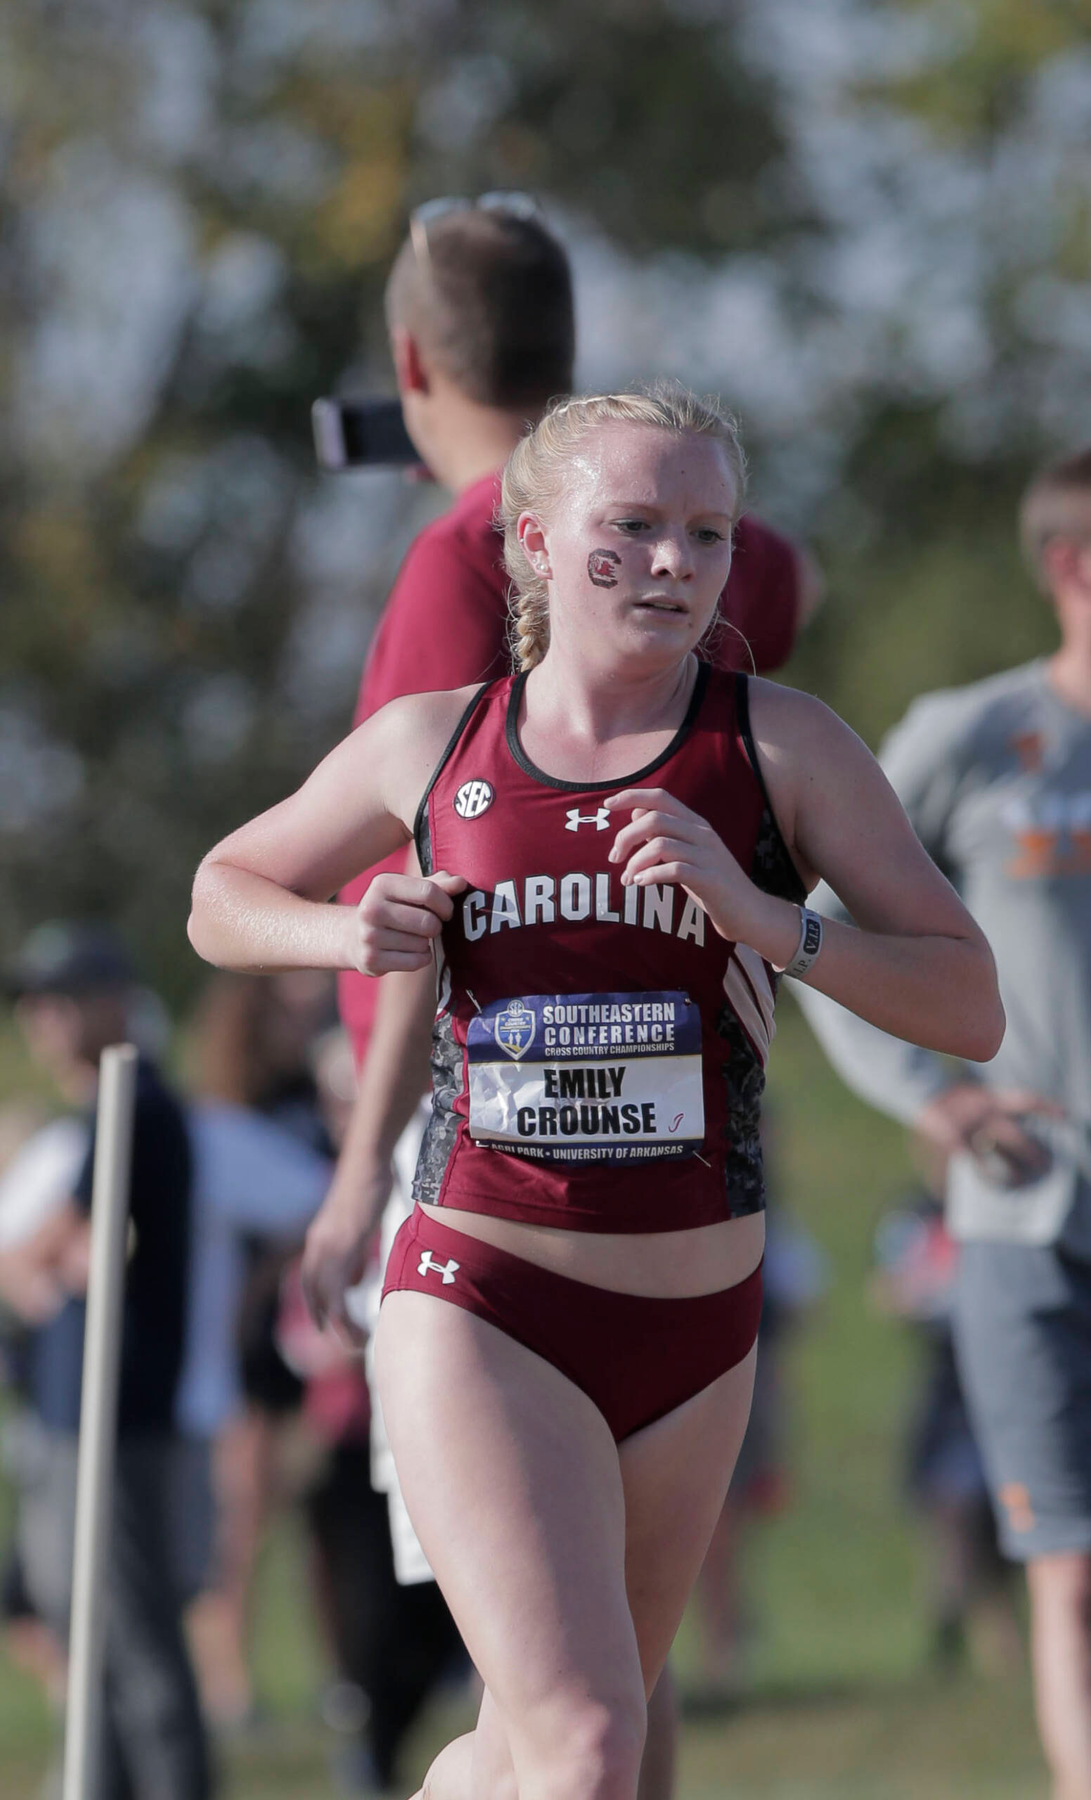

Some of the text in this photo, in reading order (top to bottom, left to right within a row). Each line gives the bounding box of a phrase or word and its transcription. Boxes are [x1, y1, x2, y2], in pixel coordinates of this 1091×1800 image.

[455, 781, 491, 818] SEC
[463, 873, 705, 948] CAROLINA
[543, 1003, 675, 1024] SOUTHEASTERN
[544, 1024, 675, 1045] CONFERENCE
[545, 1042, 675, 1057] CROSS COUNTRY CHAMPIONSHIPS
[544, 1066, 626, 1099] EMILY
[517, 1102, 657, 1137] CROUNSE
[517, 1146, 544, 1158] PARK
[552, 1148, 614, 1160] UNIVERSITY
[615, 1147, 629, 1159] OF
[629, 1145, 684, 1158] ARKANSAS
